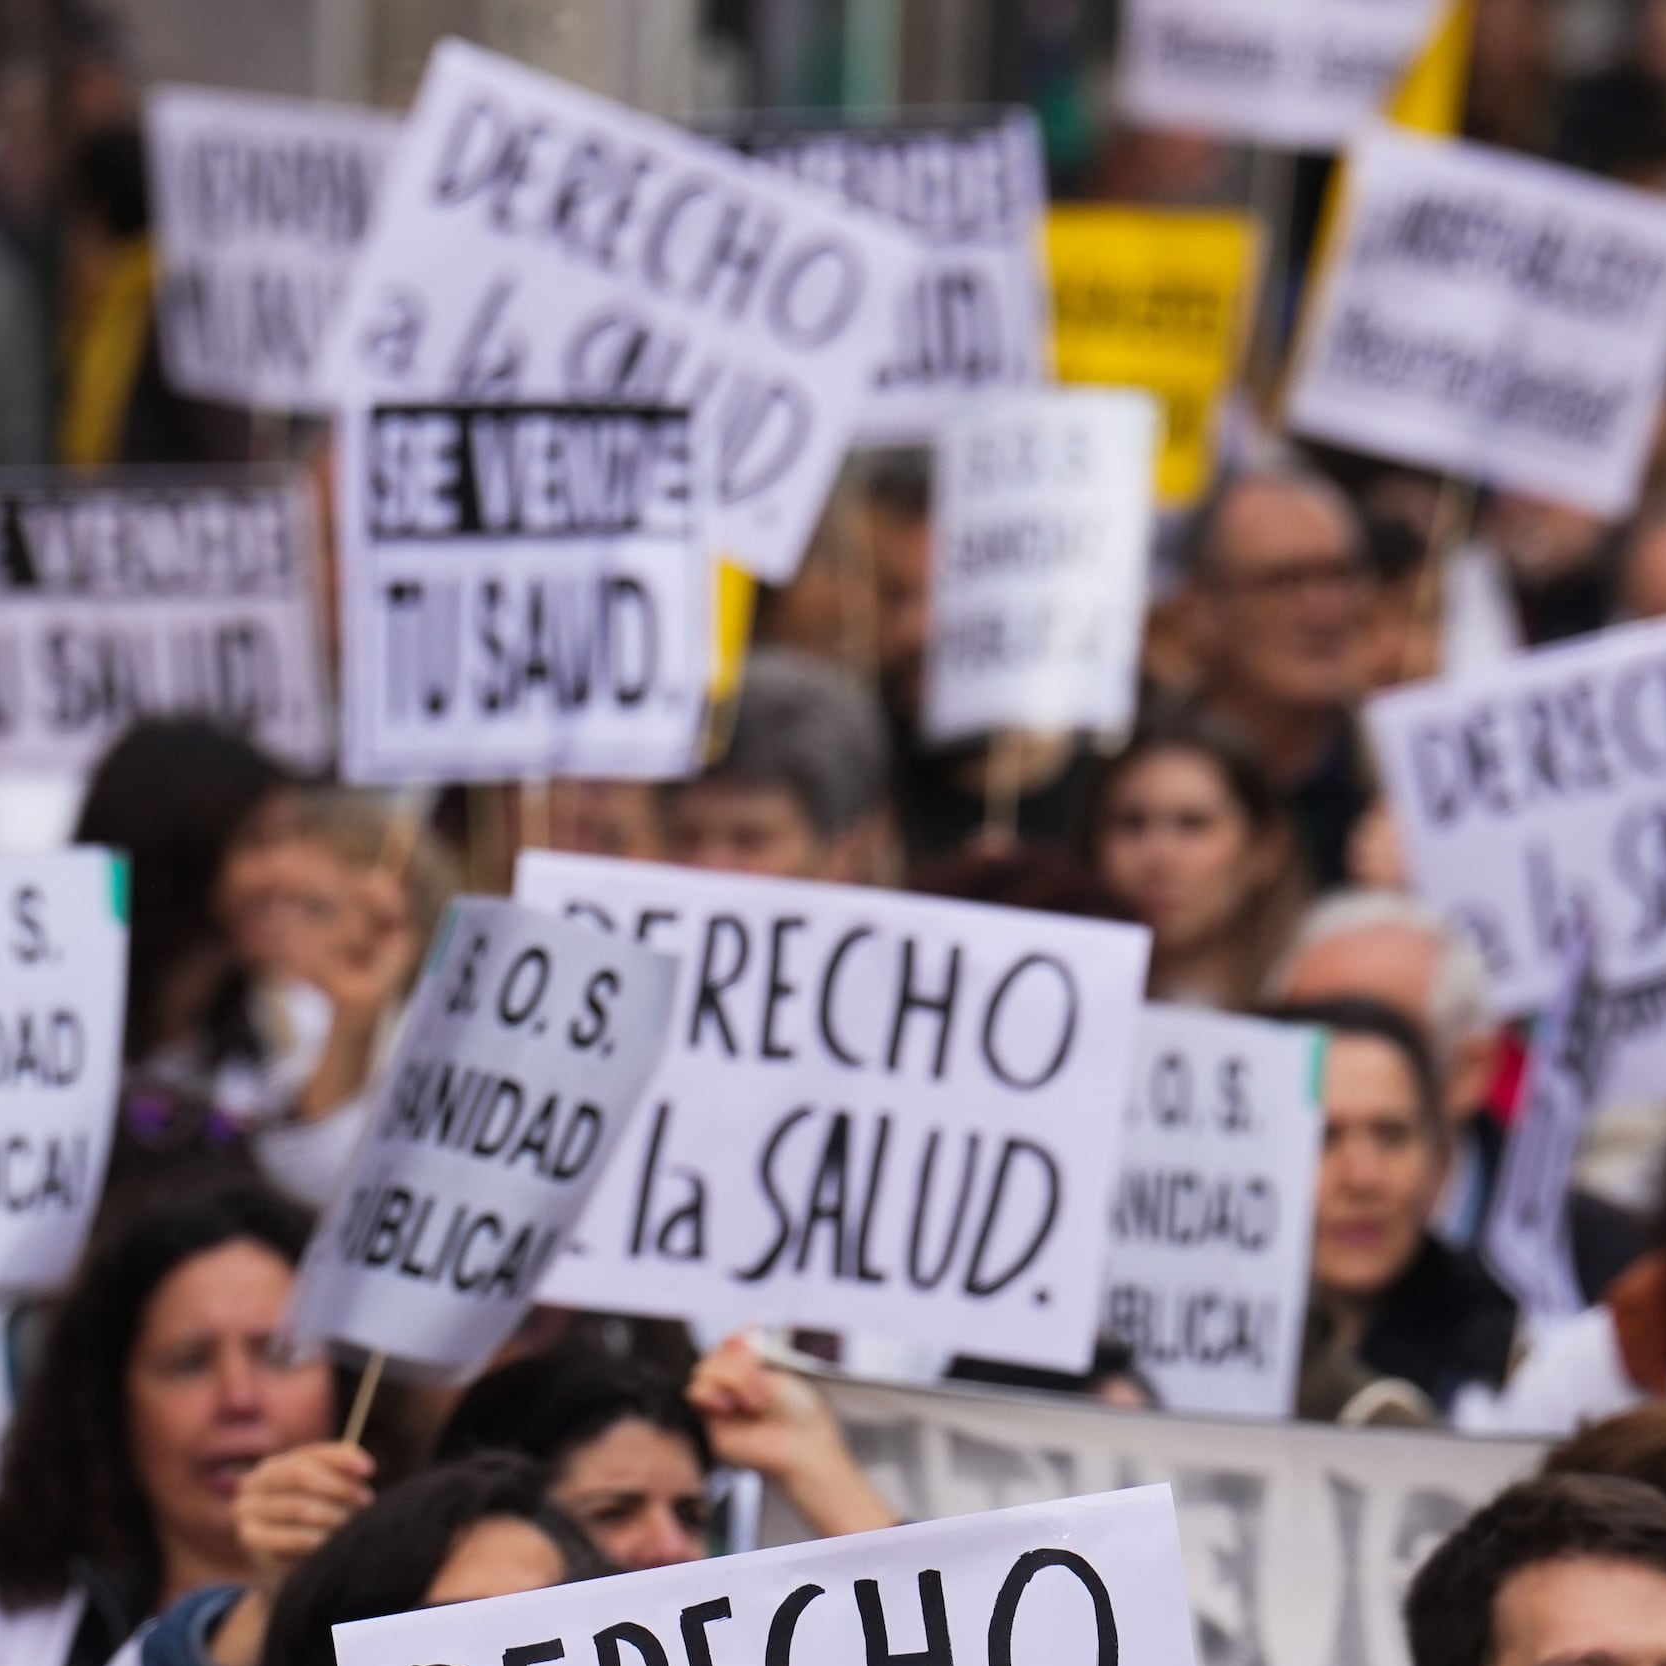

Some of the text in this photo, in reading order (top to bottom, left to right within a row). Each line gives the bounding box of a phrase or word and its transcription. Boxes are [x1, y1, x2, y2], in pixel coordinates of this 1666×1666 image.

[431, 95, 863, 353] DERECHO
[566, 899, 1080, 1092] RECHO
[623, 1100, 1063, 1309] la SALUD.
